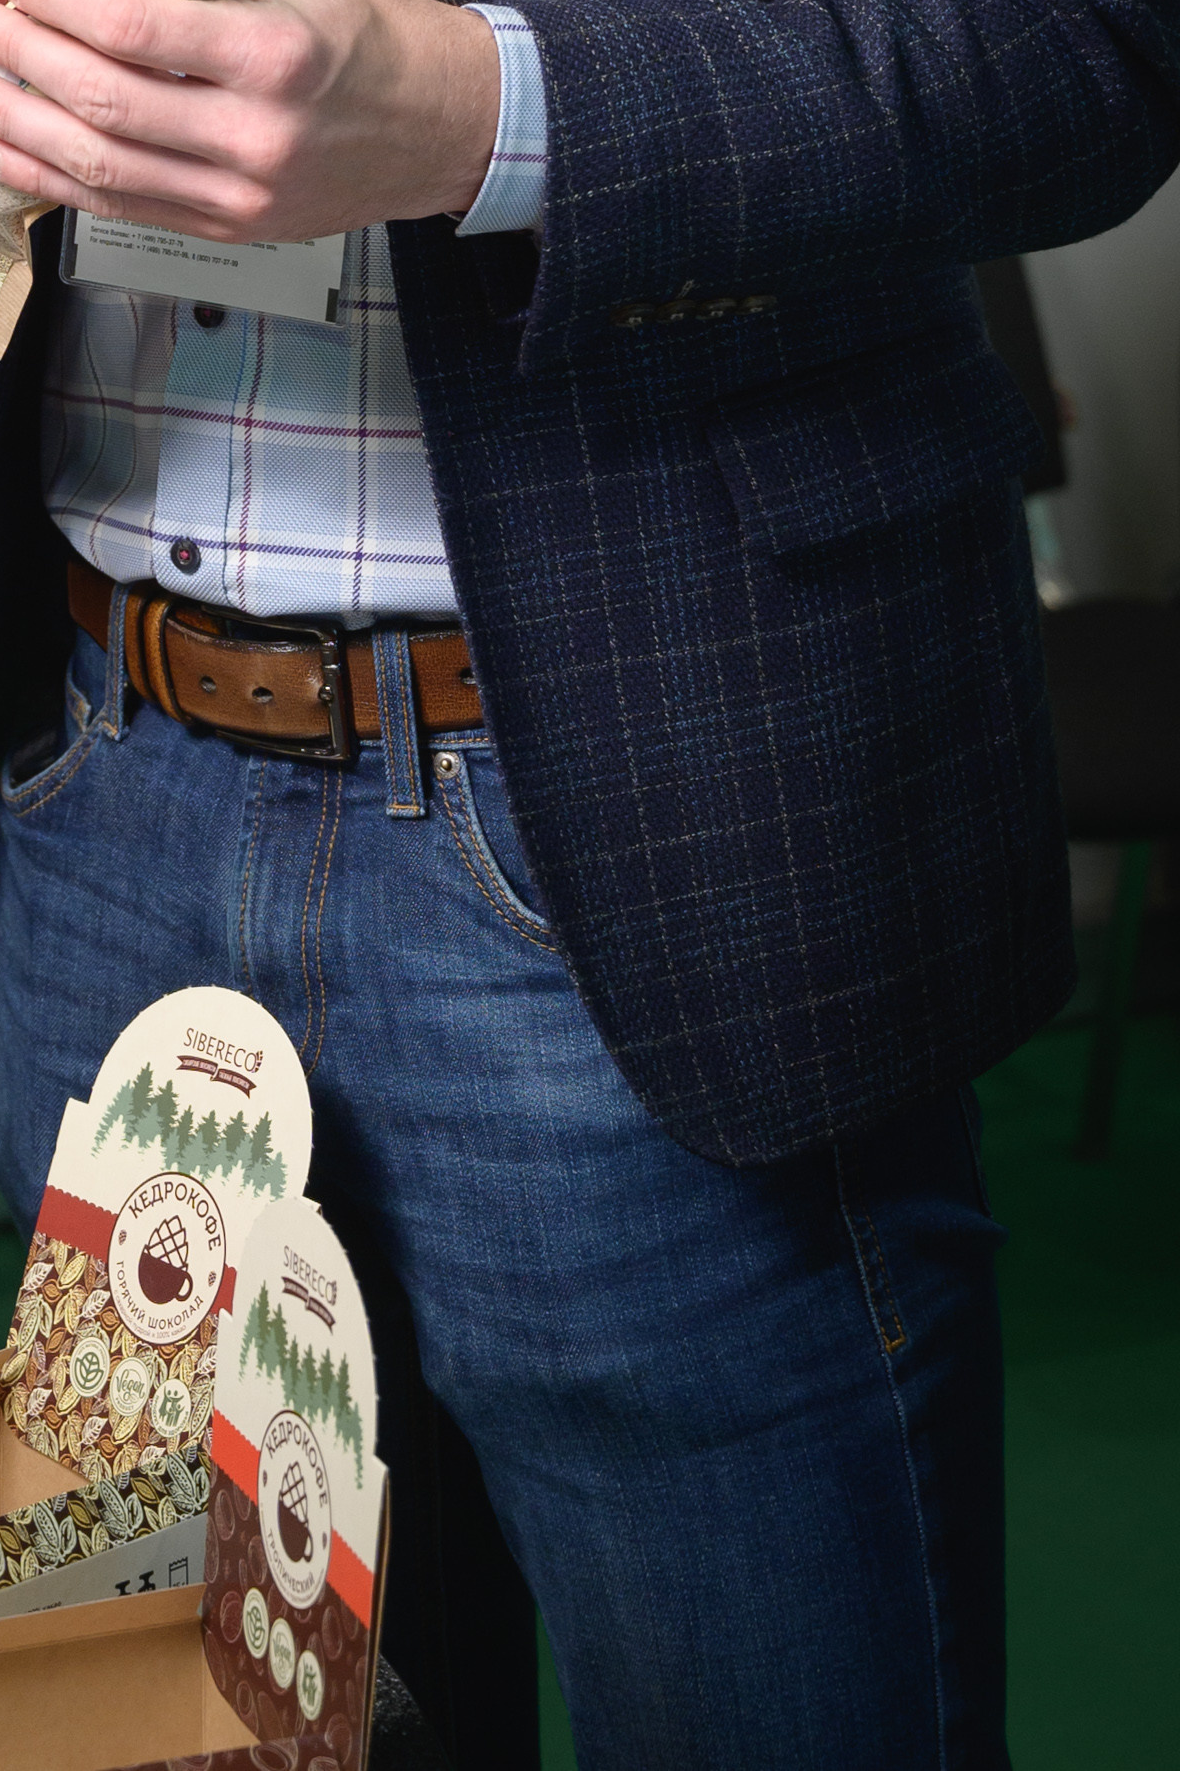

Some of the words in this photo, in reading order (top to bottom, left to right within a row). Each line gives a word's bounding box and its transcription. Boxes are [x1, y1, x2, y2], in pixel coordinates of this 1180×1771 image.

[90, 226, 110, 236] Service
[183, 1027, 257, 1073] SIBERECO
[128, 1181, 222, 1251] КЕДРОКОФЕ
[116, 1261, 146, 1324] ГОРЯЧИЙ
[147, 1295, 204, 1330] ШОКОЛАД
[283, 1245, 334, 1305] SIBERECO
[116, 1368, 146, 1402] Vegan
[266, 1421, 328, 1509] КЕДРОКОФЕ
[267, 1527, 315, 1594] ТРОПИЧЕСКИЙ
